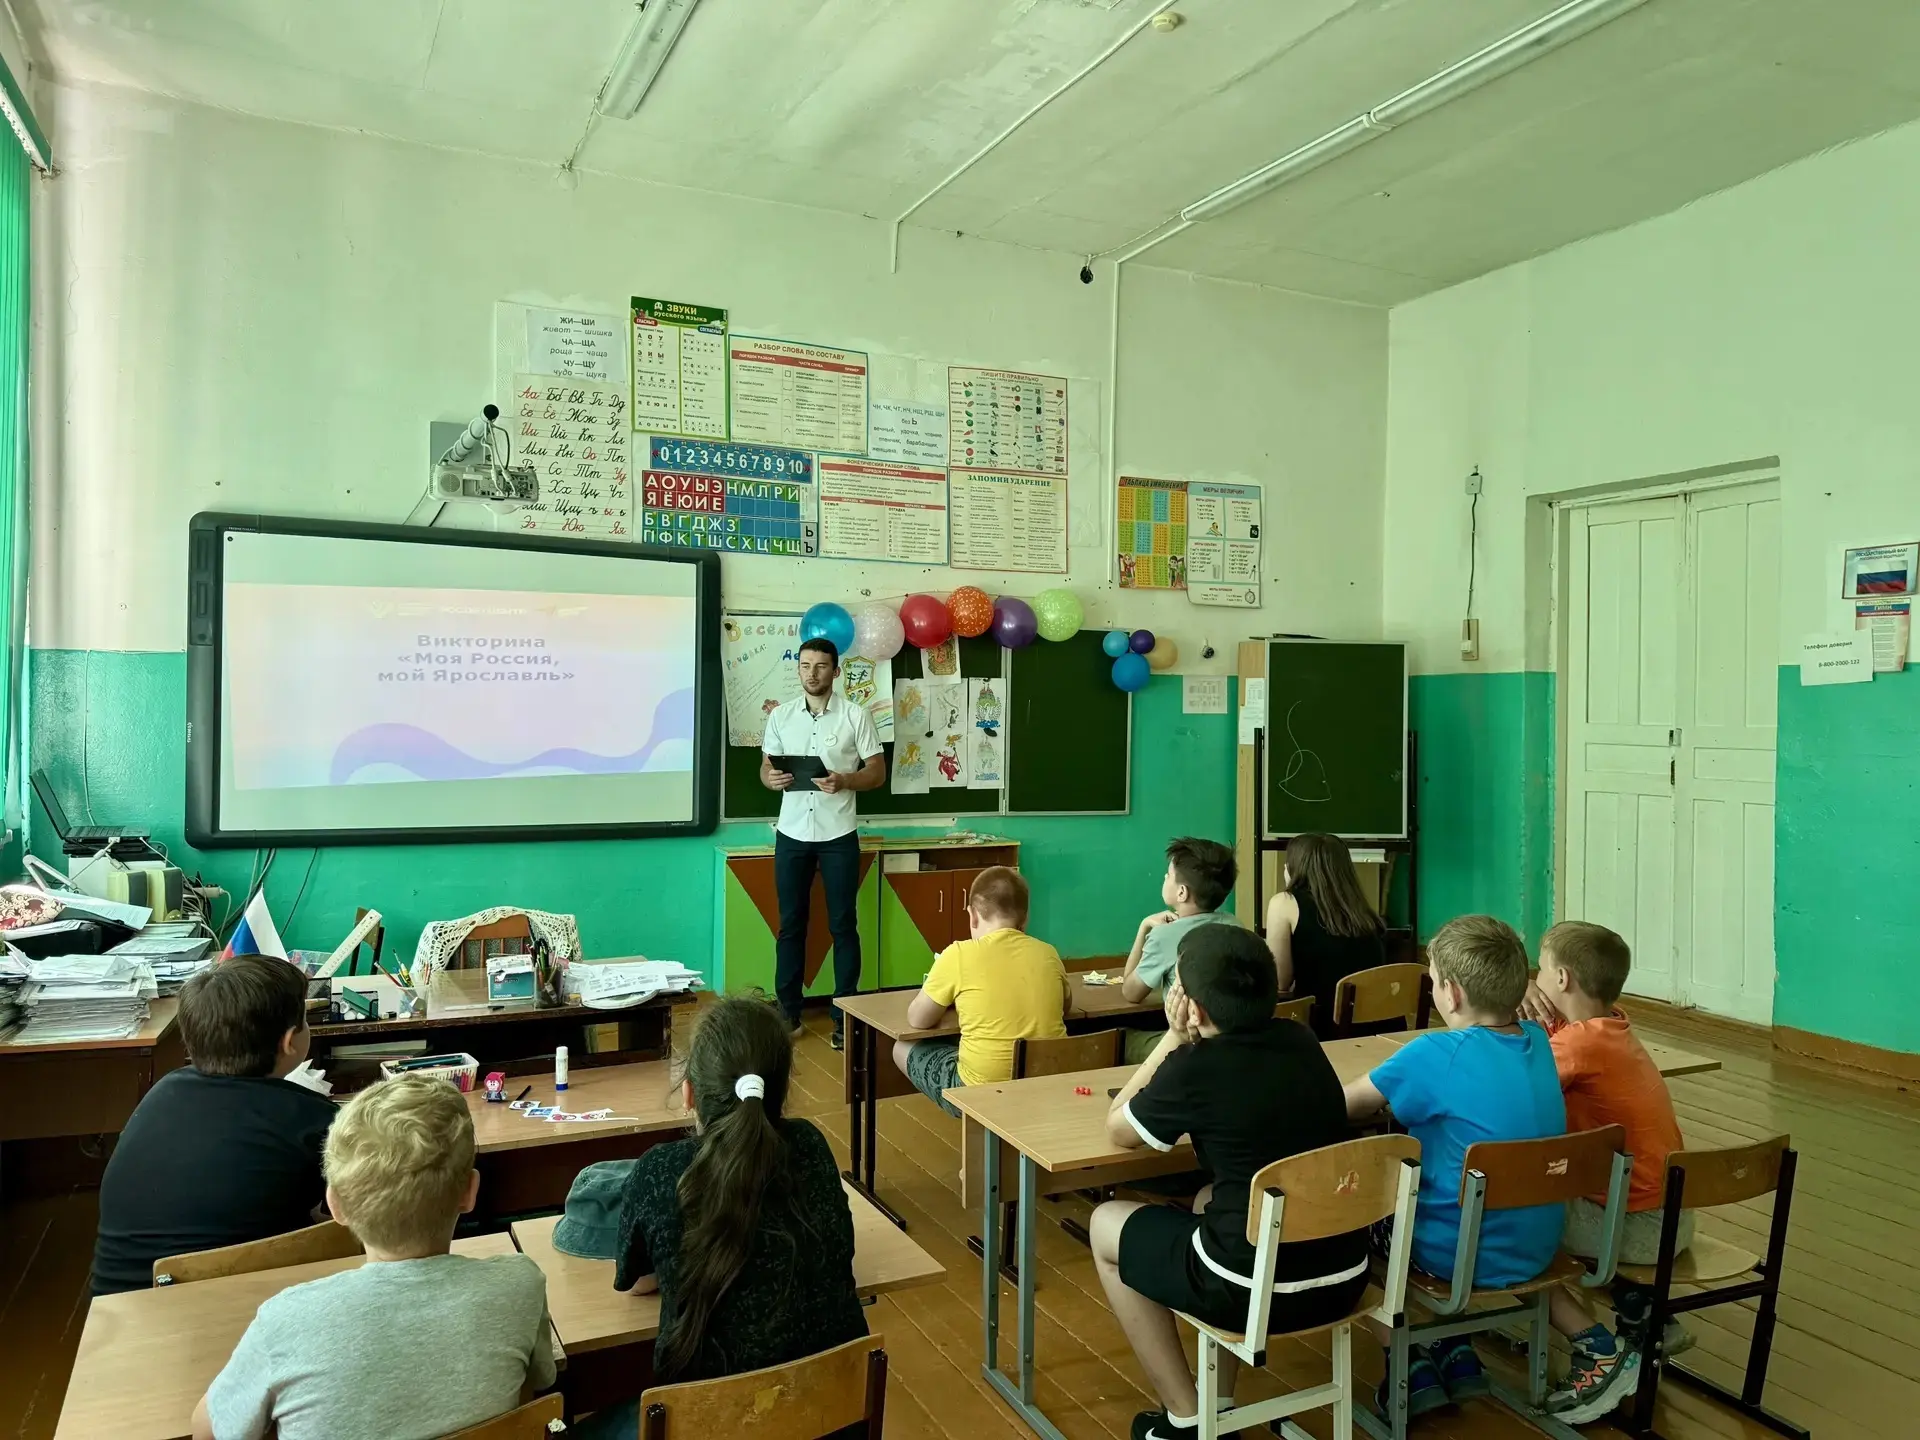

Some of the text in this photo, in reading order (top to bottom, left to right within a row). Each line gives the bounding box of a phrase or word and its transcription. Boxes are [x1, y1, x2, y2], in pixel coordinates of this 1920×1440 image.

[654, 311, 684, 319] русского
[667, 304, 697, 315] ЗВУКИ
[585, 329, 613, 337] шишка
[754, 343, 780, 351] РАЗБОР
[782, 346, 804, 355] СЛОВА
[816, 351, 845, 360] СОСТАВУ
[1007, 374, 1039, 382] ПРАВИЛЬНО
[518, 385, 625, 413] Аа Бб Вв Гг Дд
[521, 403, 620, 430] Ее Ёё Жж Зз
[521, 422, 625, 444] Ии Йй Кк Лл
[519, 441, 625, 462] Мм Нн Оо Пп
[661, 446, 803, 474] 0 1 2 3 4 5 6 7 8 9 10
[847, 459, 884, 467] ФОНЕТИЧЕСКИЙ
[549, 461, 562, 475] Сс
[574, 464, 601, 478] Тт
[613, 467, 627, 485] Уу
[967, 475, 1051, 487] ЗАПОМНИ УДАРЕНИЕ
[548, 480, 624, 498] Хх Цц Чч
[555, 499, 583, 516] Щщ
[521, 515, 626, 534] Ээ Юю Яя
[722, 618, 798, 642] Весёлы
[417, 634, 546, 649] Викторина
[398, 653, 560, 667] «Моя Россия,
[1818, 659, 1860, 668] 8-800-2000-122
[378, 668, 575, 684] мой Ярославль»
